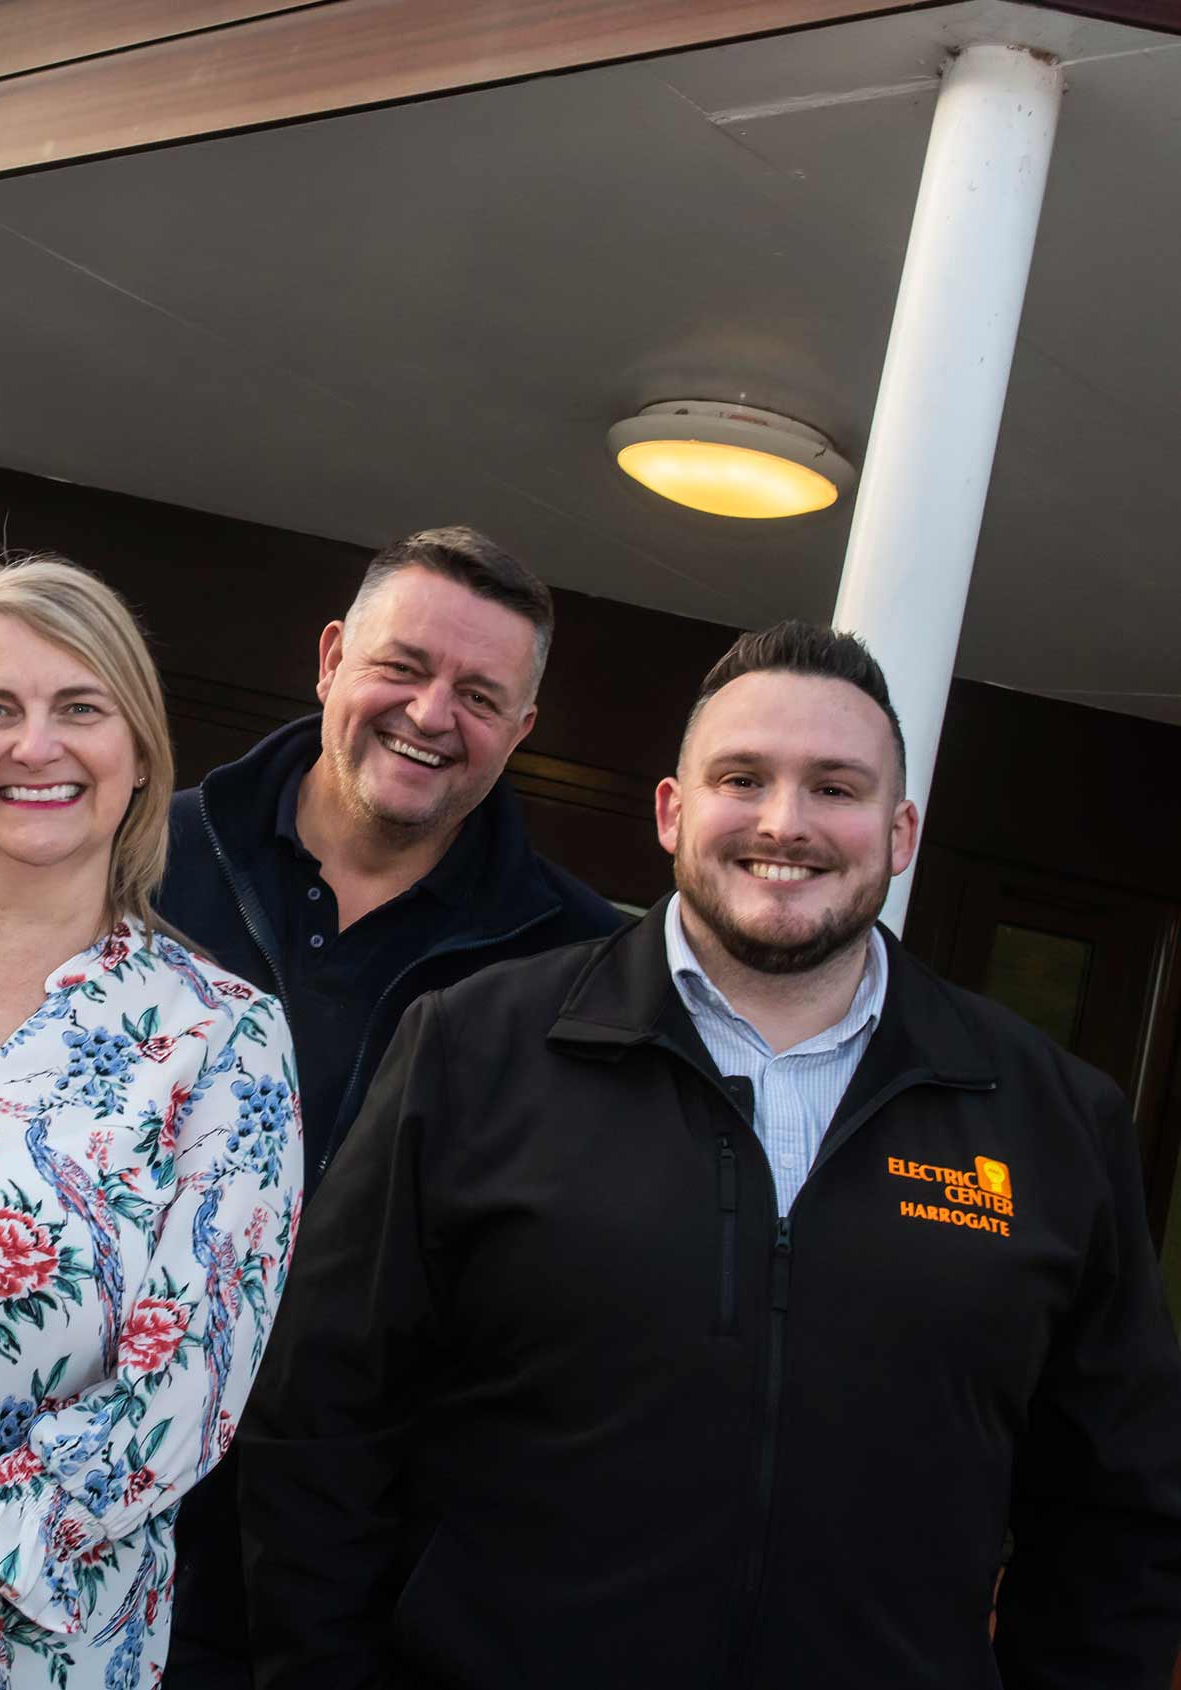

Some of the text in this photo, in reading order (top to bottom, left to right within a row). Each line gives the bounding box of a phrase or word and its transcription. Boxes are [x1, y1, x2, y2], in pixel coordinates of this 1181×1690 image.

[887, 1156, 979, 1188] ELECTRIC
[944, 1185, 1015, 1216] CENTER
[900, 1201, 1010, 1237] HARROGATE
